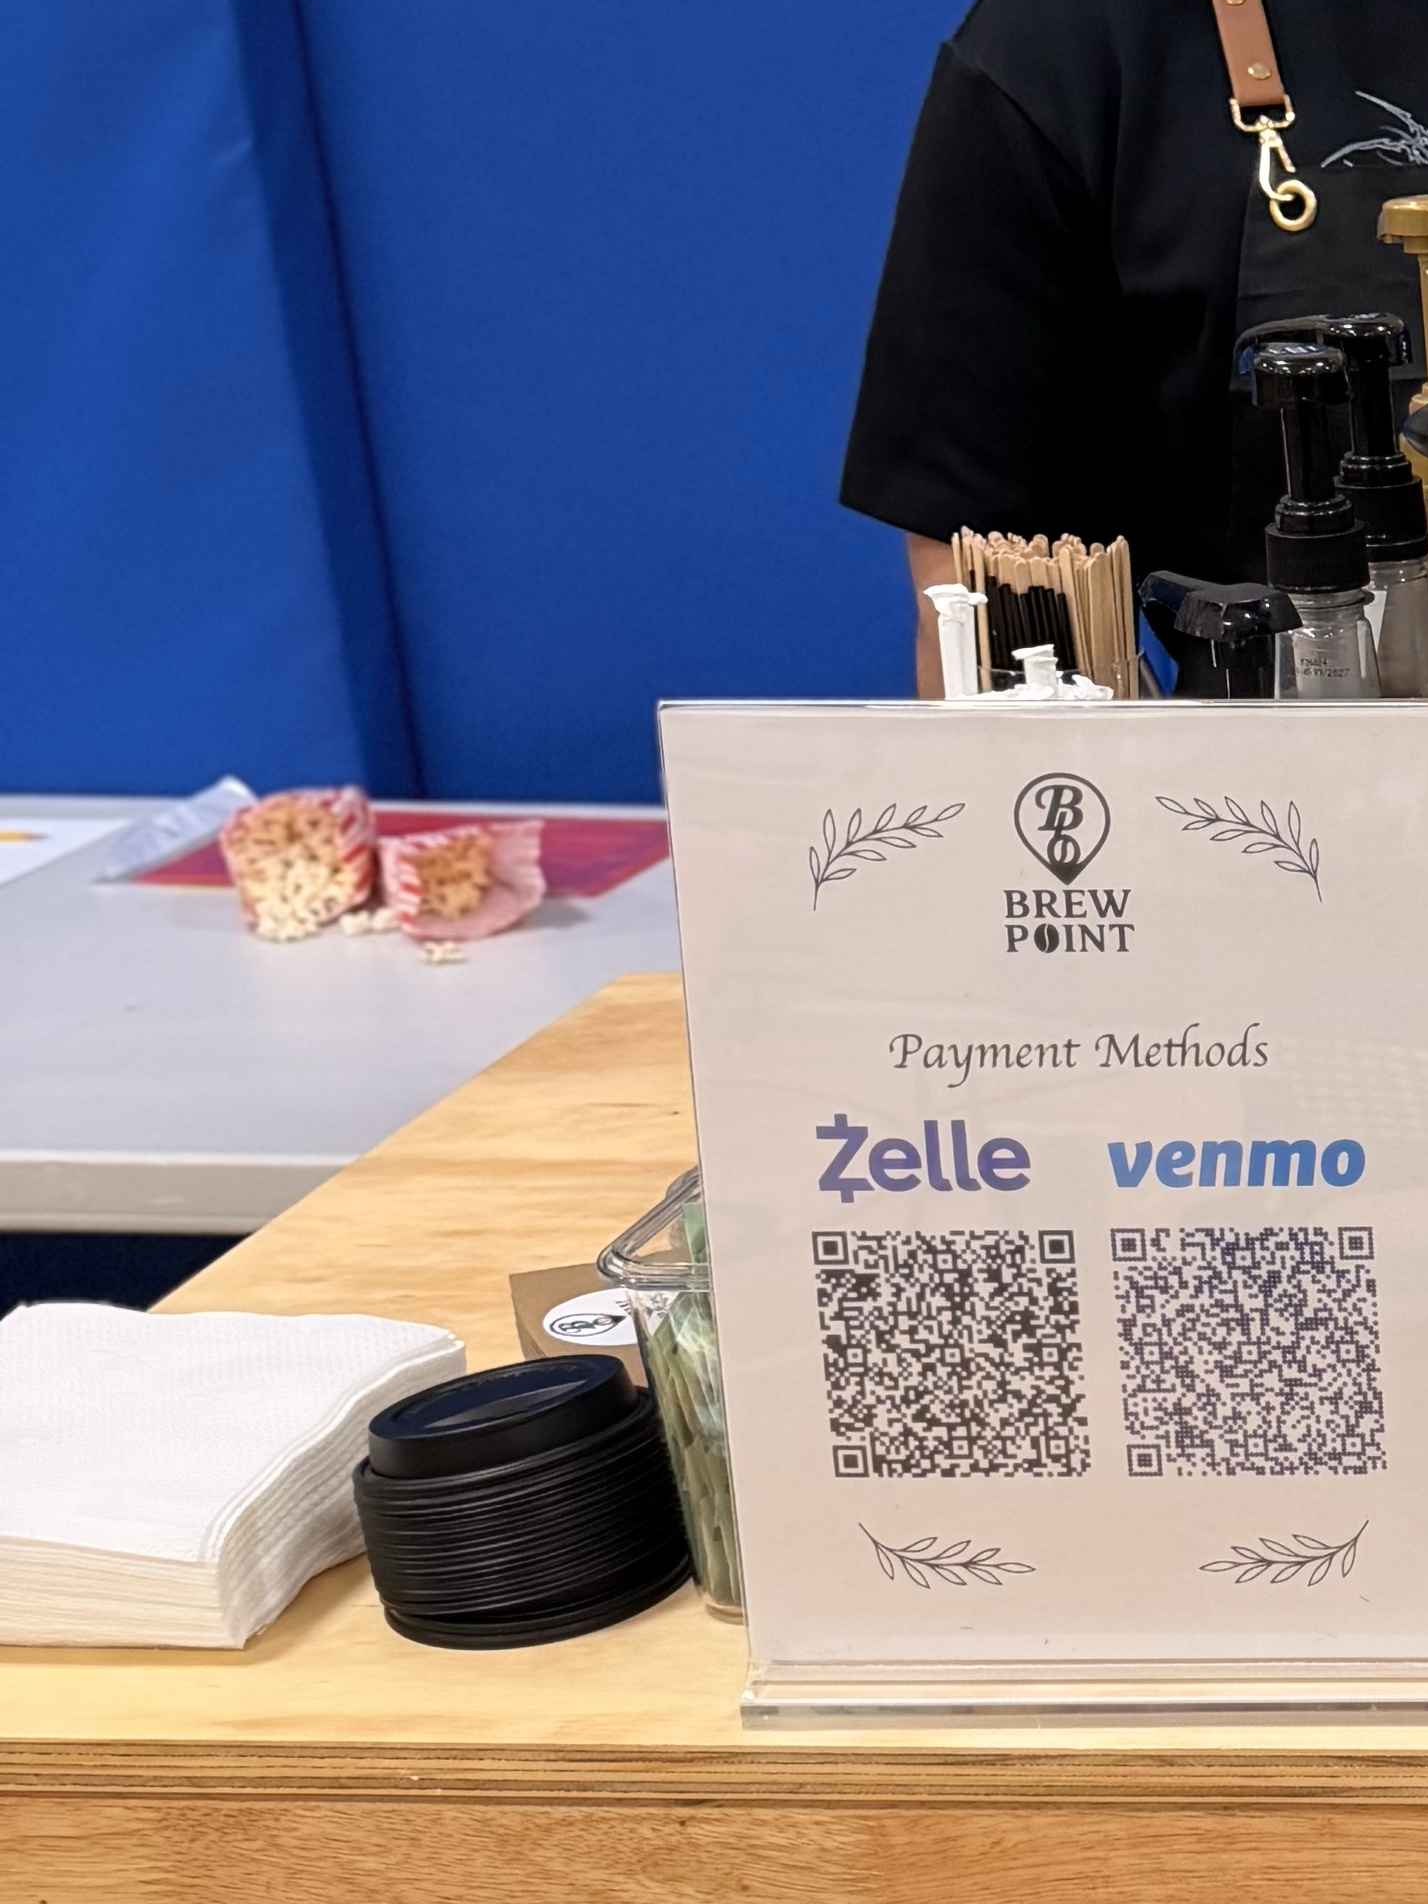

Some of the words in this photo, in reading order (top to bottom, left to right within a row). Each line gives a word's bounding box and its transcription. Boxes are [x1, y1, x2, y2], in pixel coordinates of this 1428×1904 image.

[1004, 888, 1132, 919] BREW
[1005, 923, 1135, 954] POINT
[889, 1033, 1081, 1089] Payment
[1094, 1022, 1268, 1068] Methods
[815, 1112, 1032, 1204] Zelle
[1106, 1138, 1366, 1189] venmo
